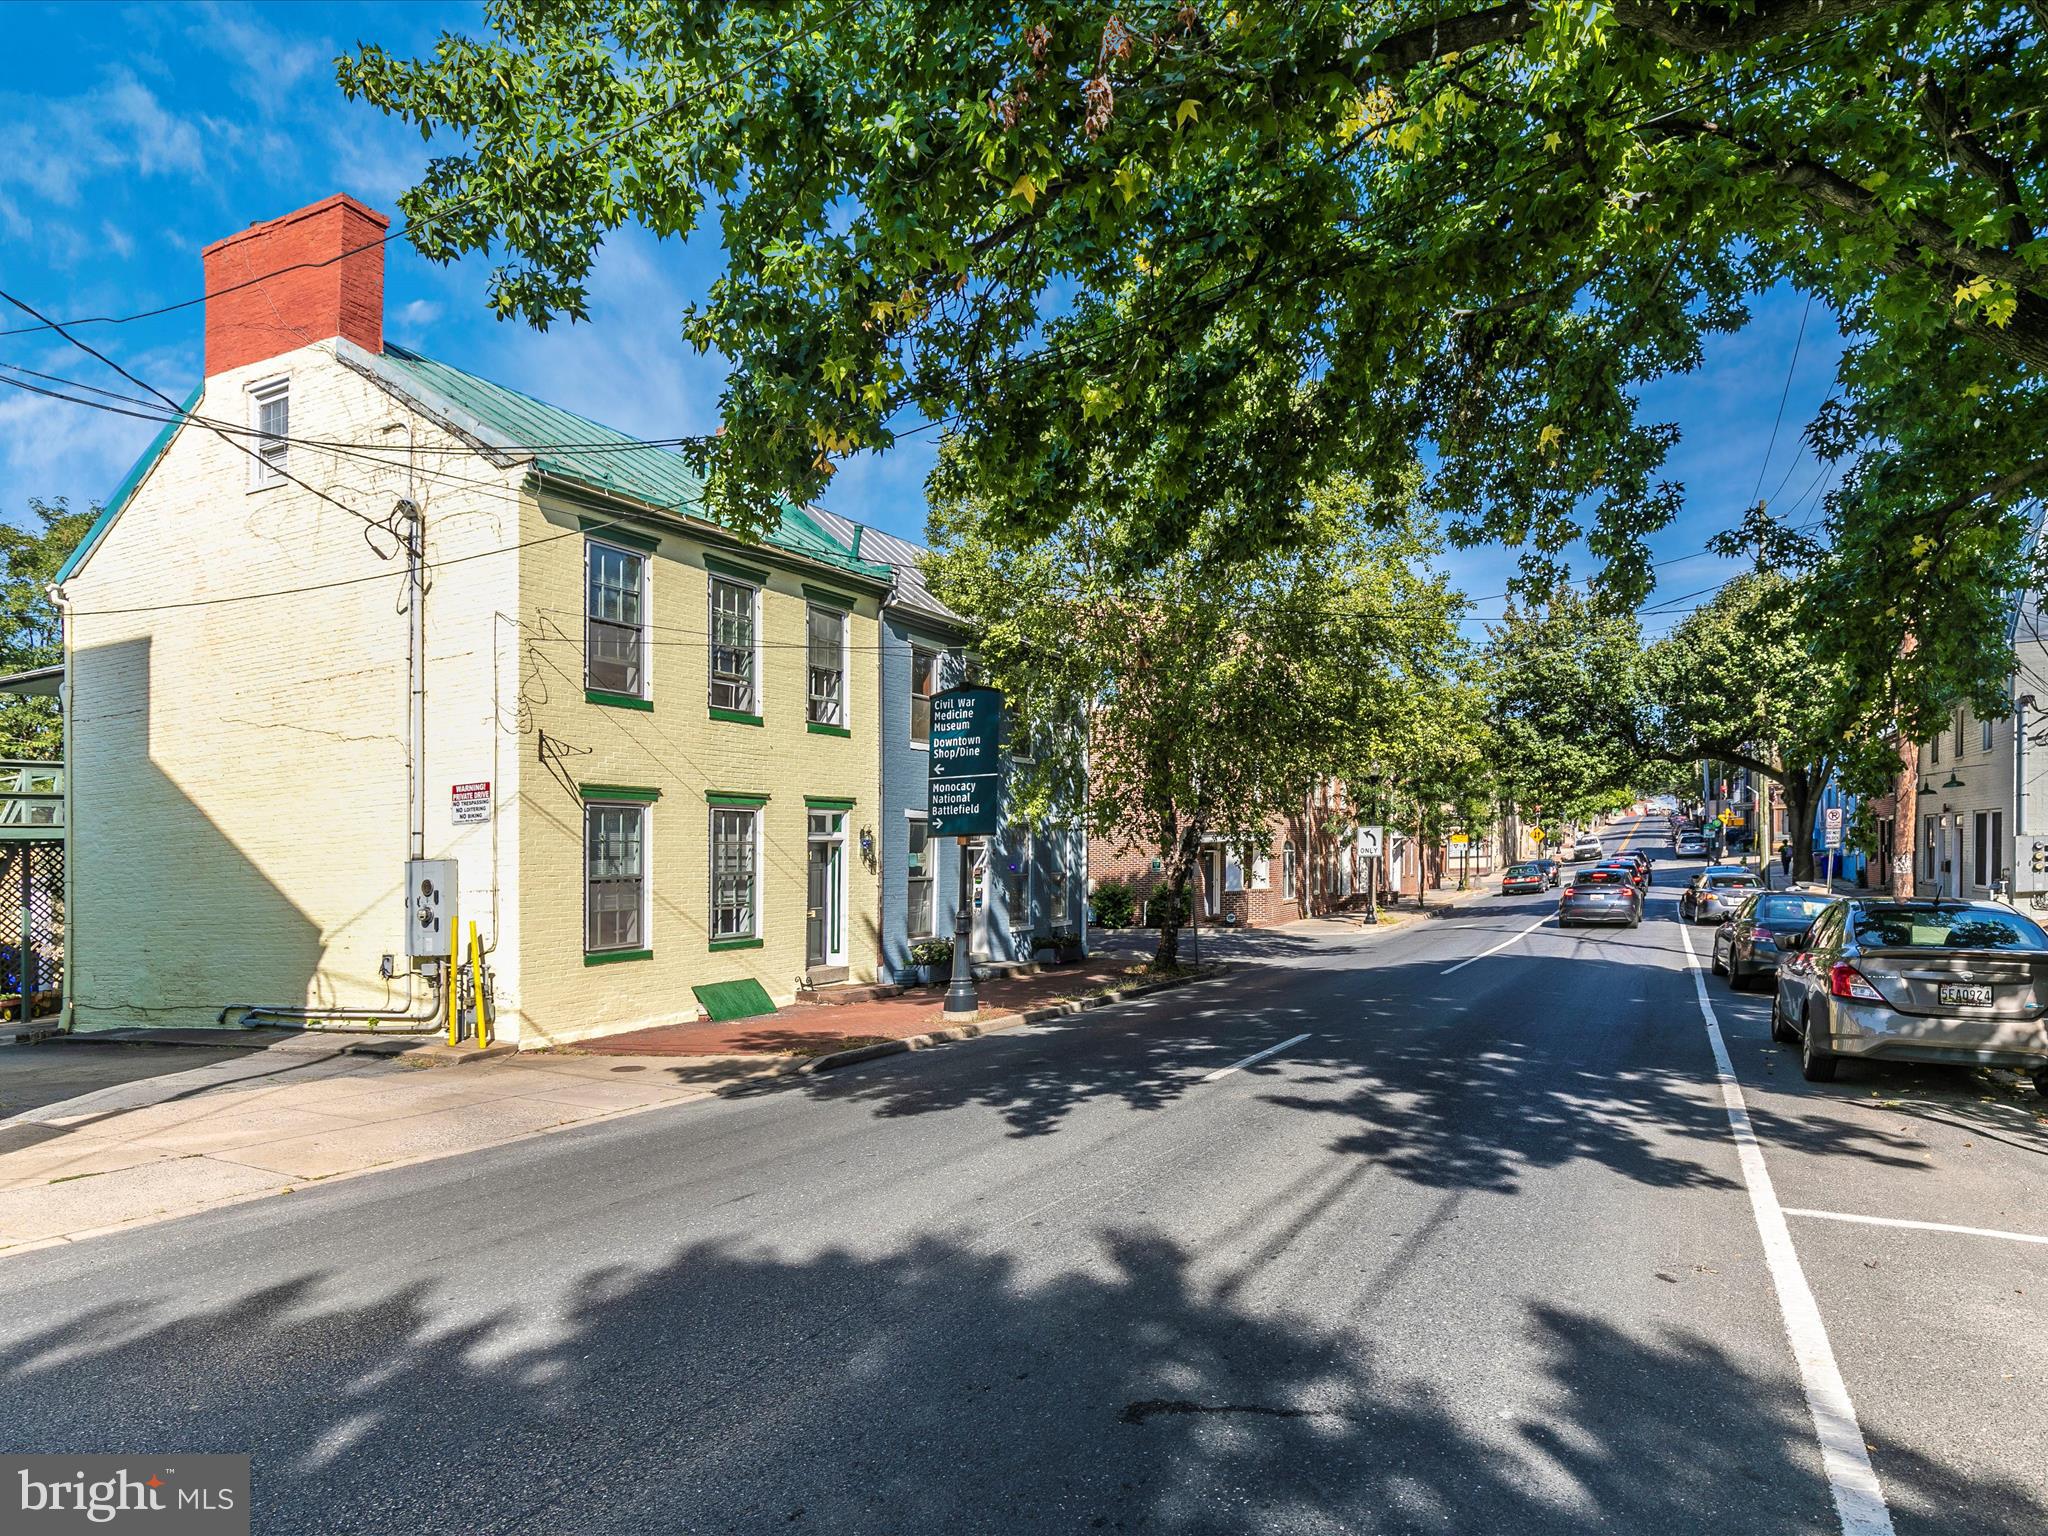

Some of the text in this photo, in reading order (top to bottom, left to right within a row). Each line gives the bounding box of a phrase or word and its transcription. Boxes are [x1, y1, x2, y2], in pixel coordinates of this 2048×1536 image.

[934, 698, 976, 710] Civil War
[934, 709, 974, 721] Medicine
[934, 721, 970, 732] Museum
[933, 736, 980, 748] Downtown
[933, 747, 980, 760] Shop/Dine
[456, 783, 486, 793] WARNING!
[932, 782, 976, 792] Monocacy
[452, 790, 489, 800] PRIVATE DRIVE
[932, 792, 970, 804] National
[932, 803, 980, 816] Battlefield
[1360, 847, 1378, 855] ONLY
[1941, 988, 1991, 1002] 5EA0924
